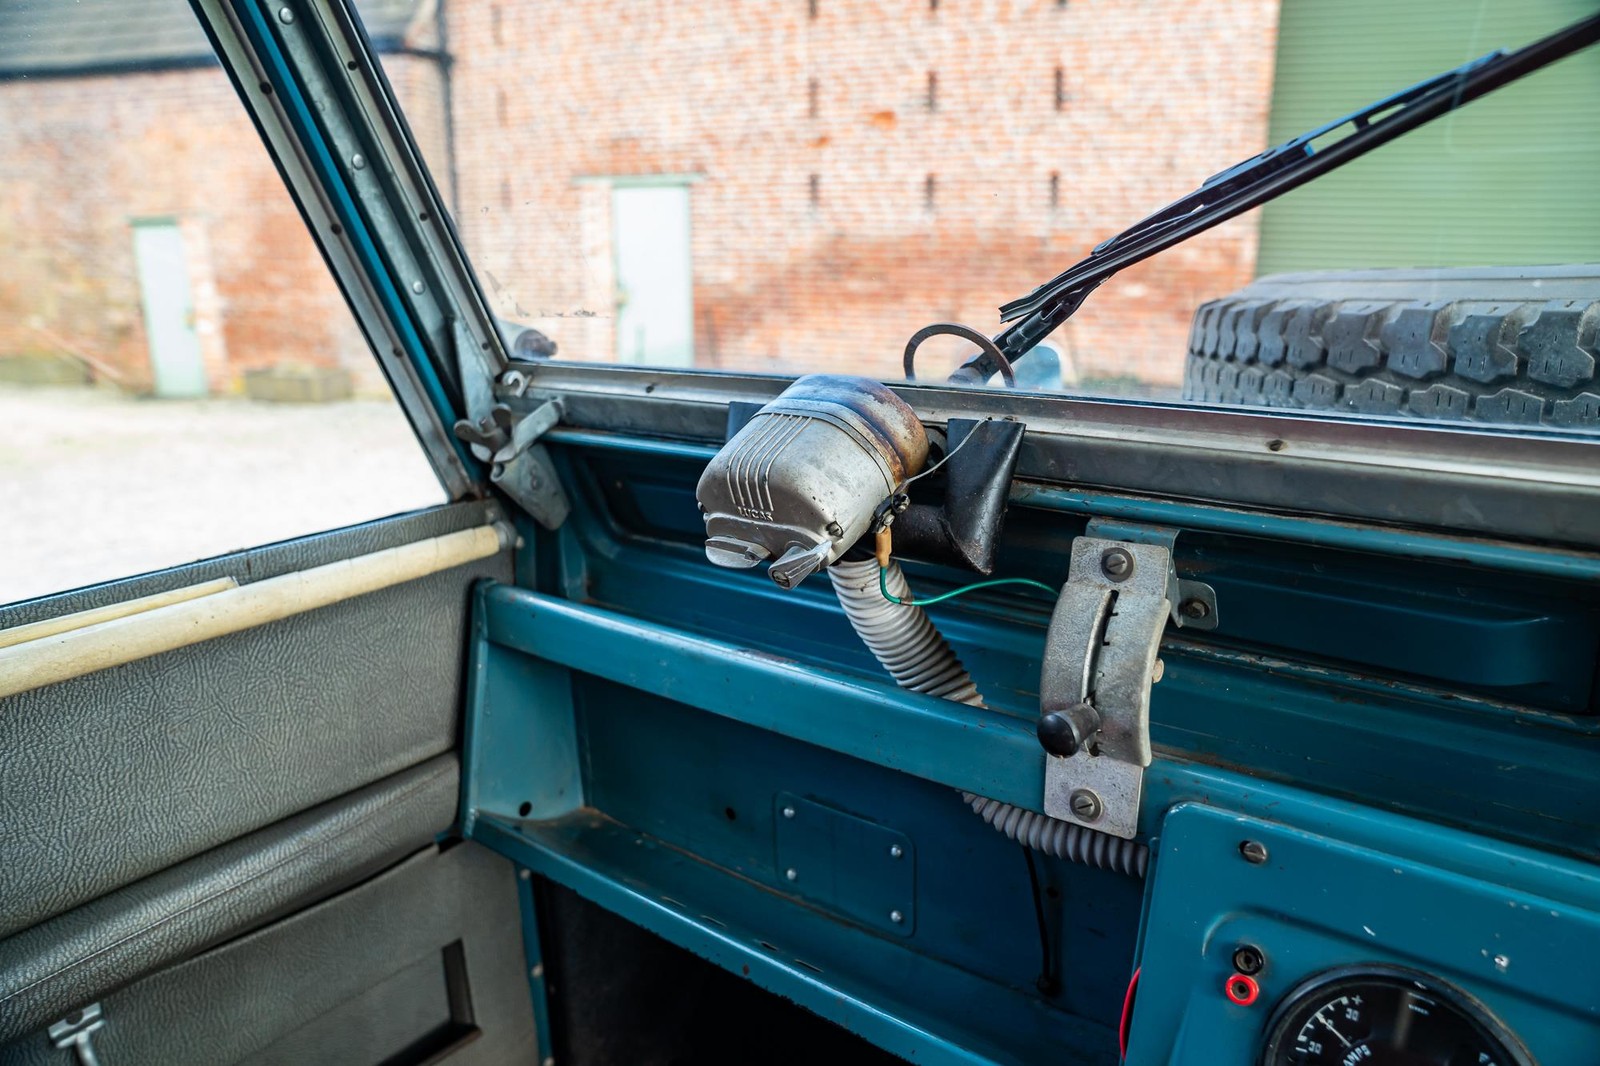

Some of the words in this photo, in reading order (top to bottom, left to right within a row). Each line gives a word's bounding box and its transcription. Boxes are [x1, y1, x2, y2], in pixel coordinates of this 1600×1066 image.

[737, 506, 774, 521] LUCAS
[1345, 1008, 1360, 1022] 30
[1308, 1041, 1322, 1055] 30
[1343, 1044, 1371, 1066] AMPS
